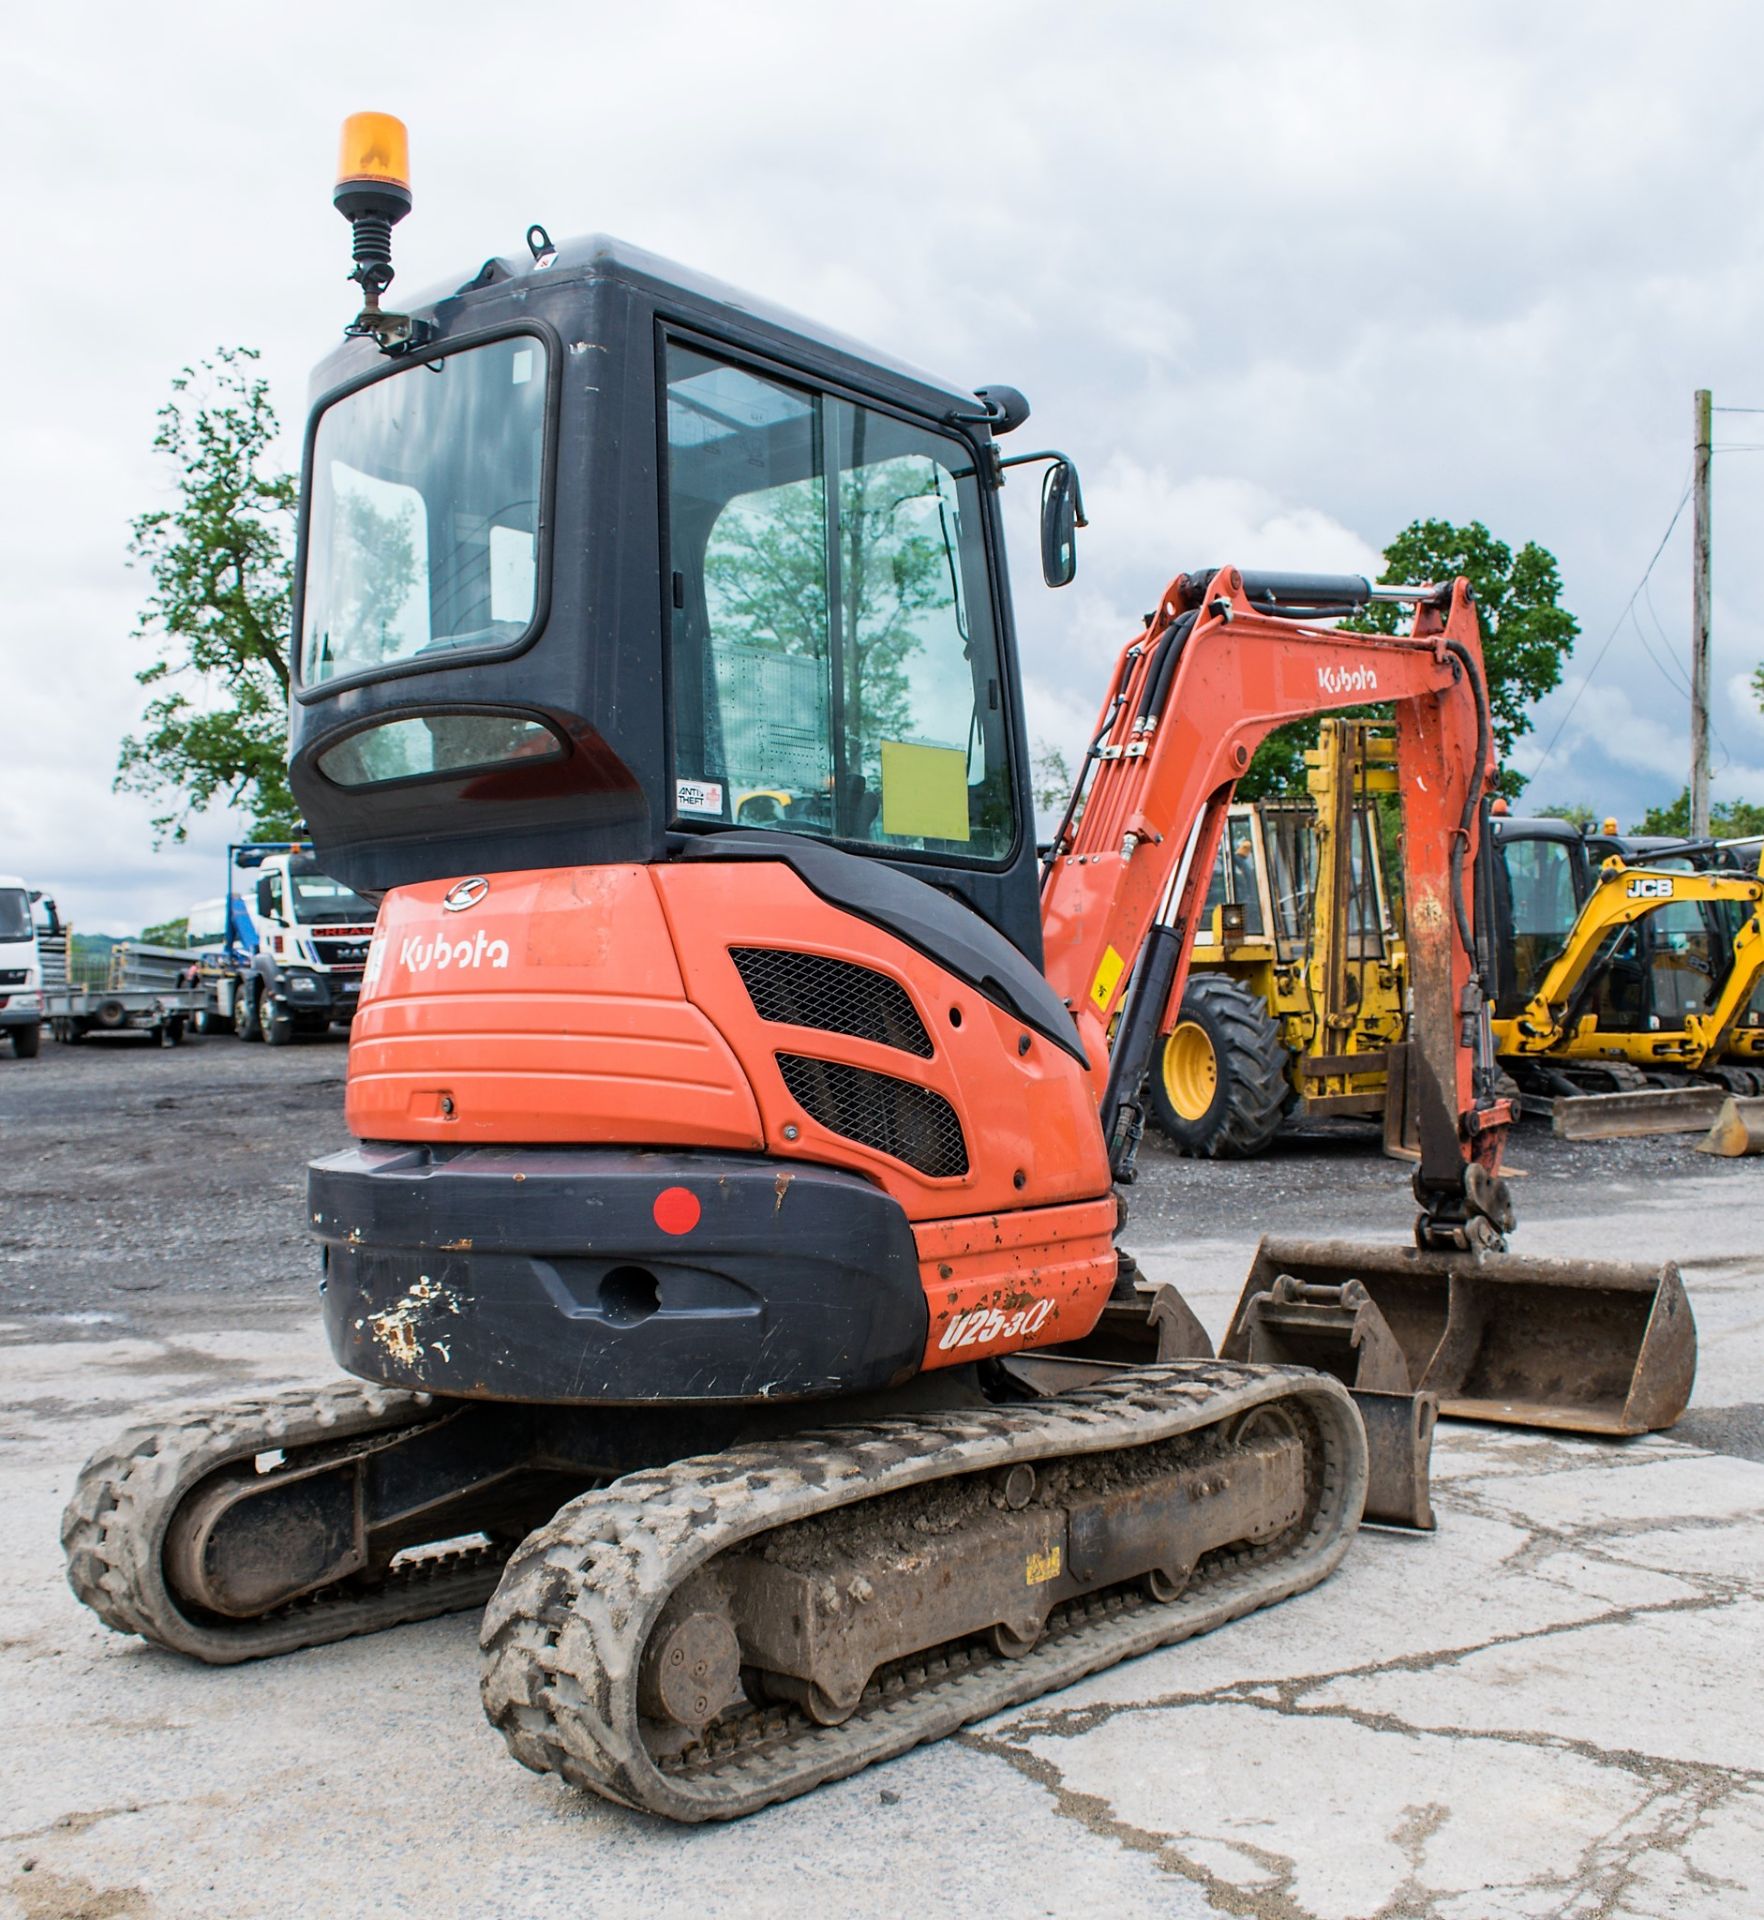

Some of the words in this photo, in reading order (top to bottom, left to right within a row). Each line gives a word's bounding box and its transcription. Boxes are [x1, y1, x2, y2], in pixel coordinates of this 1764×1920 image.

[1317, 664, 1377, 693] Kubota
[677, 795, 705, 806] THEFT
[678, 787, 699, 797] ANTI
[1627, 879, 1673, 897] JCB
[399, 929, 510, 972] Kubota
